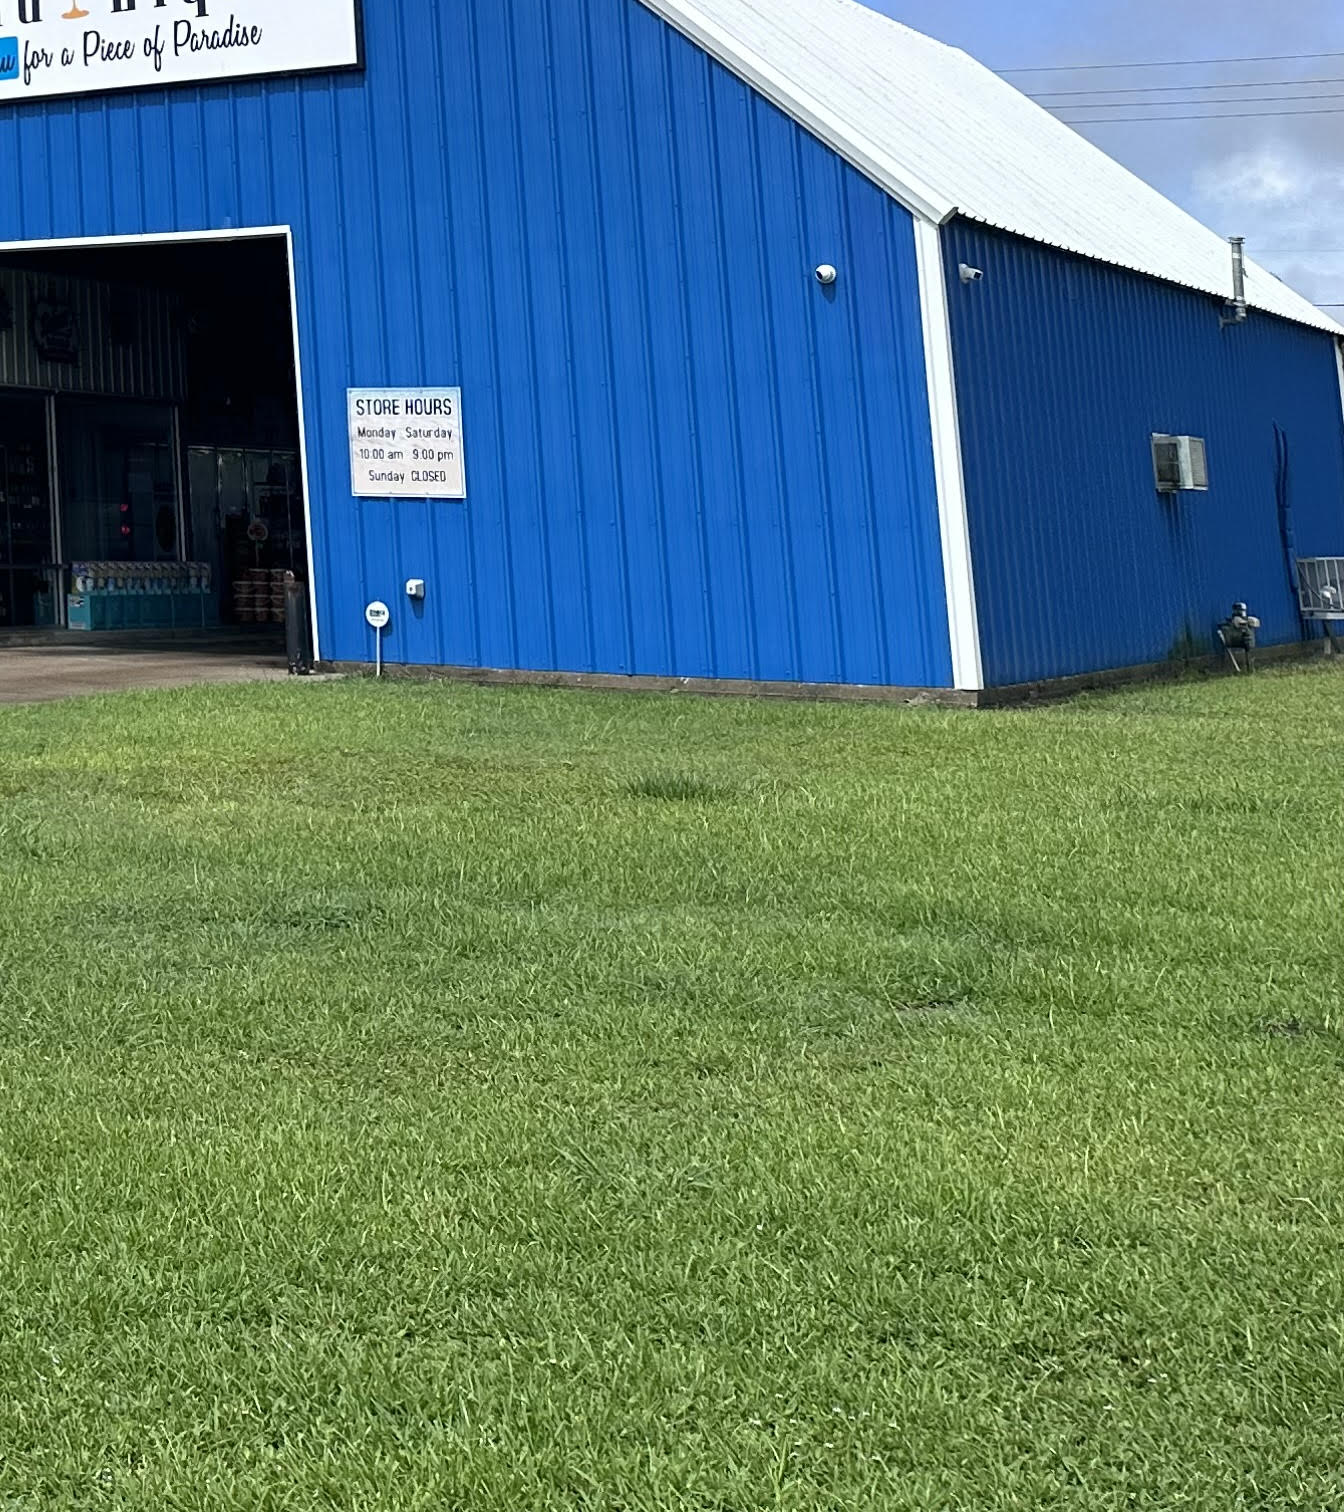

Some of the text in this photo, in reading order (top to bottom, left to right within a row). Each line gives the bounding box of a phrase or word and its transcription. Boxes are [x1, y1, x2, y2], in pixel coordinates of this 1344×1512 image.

[23, 40, 53, 86] for
[61, 47, 74, 67] a
[83, 30, 135, 66] Piece
[143, 24, 165, 72] of
[173, 14, 262, 56] Paradise
[356, 398, 452, 416] STORE HOURS
[357, 426, 452, 440] Monday Saturday
[387, 451, 404, 460] am
[437, 451, 453, 462] pm
[368, 470, 447, 484] Sunday CLOSED
